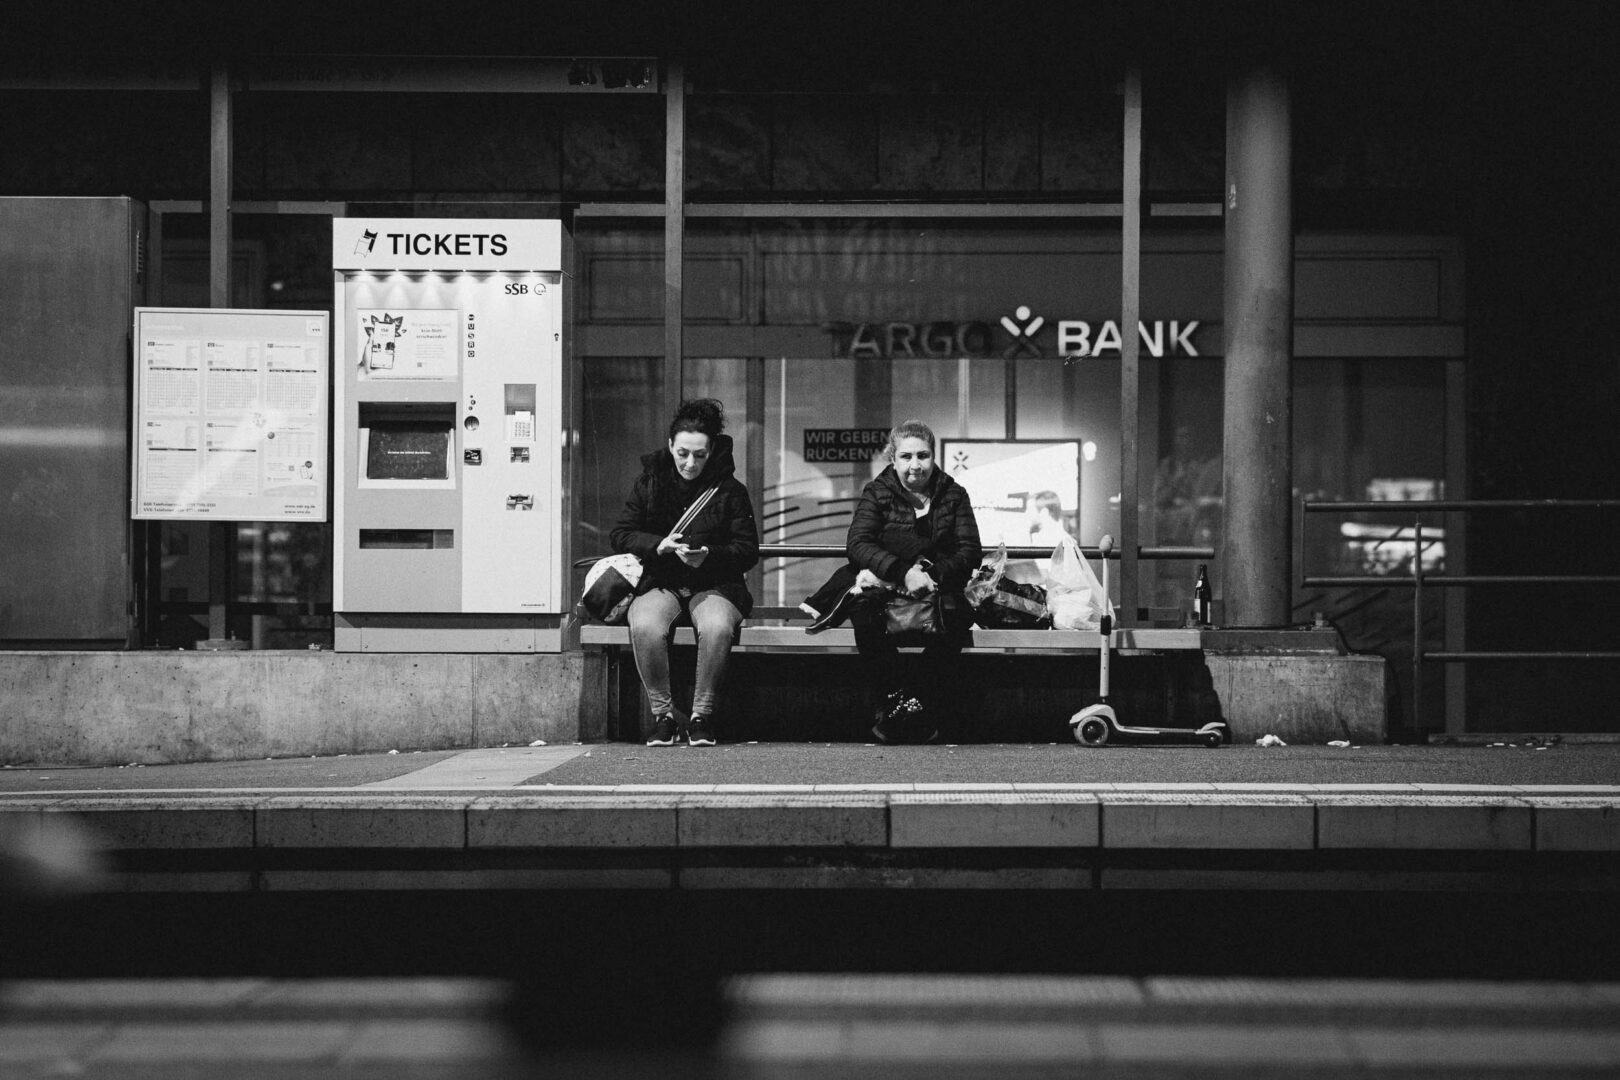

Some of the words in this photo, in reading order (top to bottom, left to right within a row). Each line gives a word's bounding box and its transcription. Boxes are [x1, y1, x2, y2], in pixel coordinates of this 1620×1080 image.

[387, 234, 508, 255] TICKETS
[504, 283, 528, 295] SSB
[823, 322, 992, 358] TARGO
[1057, 320, 1200, 358] BANK
[806, 431, 836, 443] WIR
[840, 431, 890, 443] GEBEN
